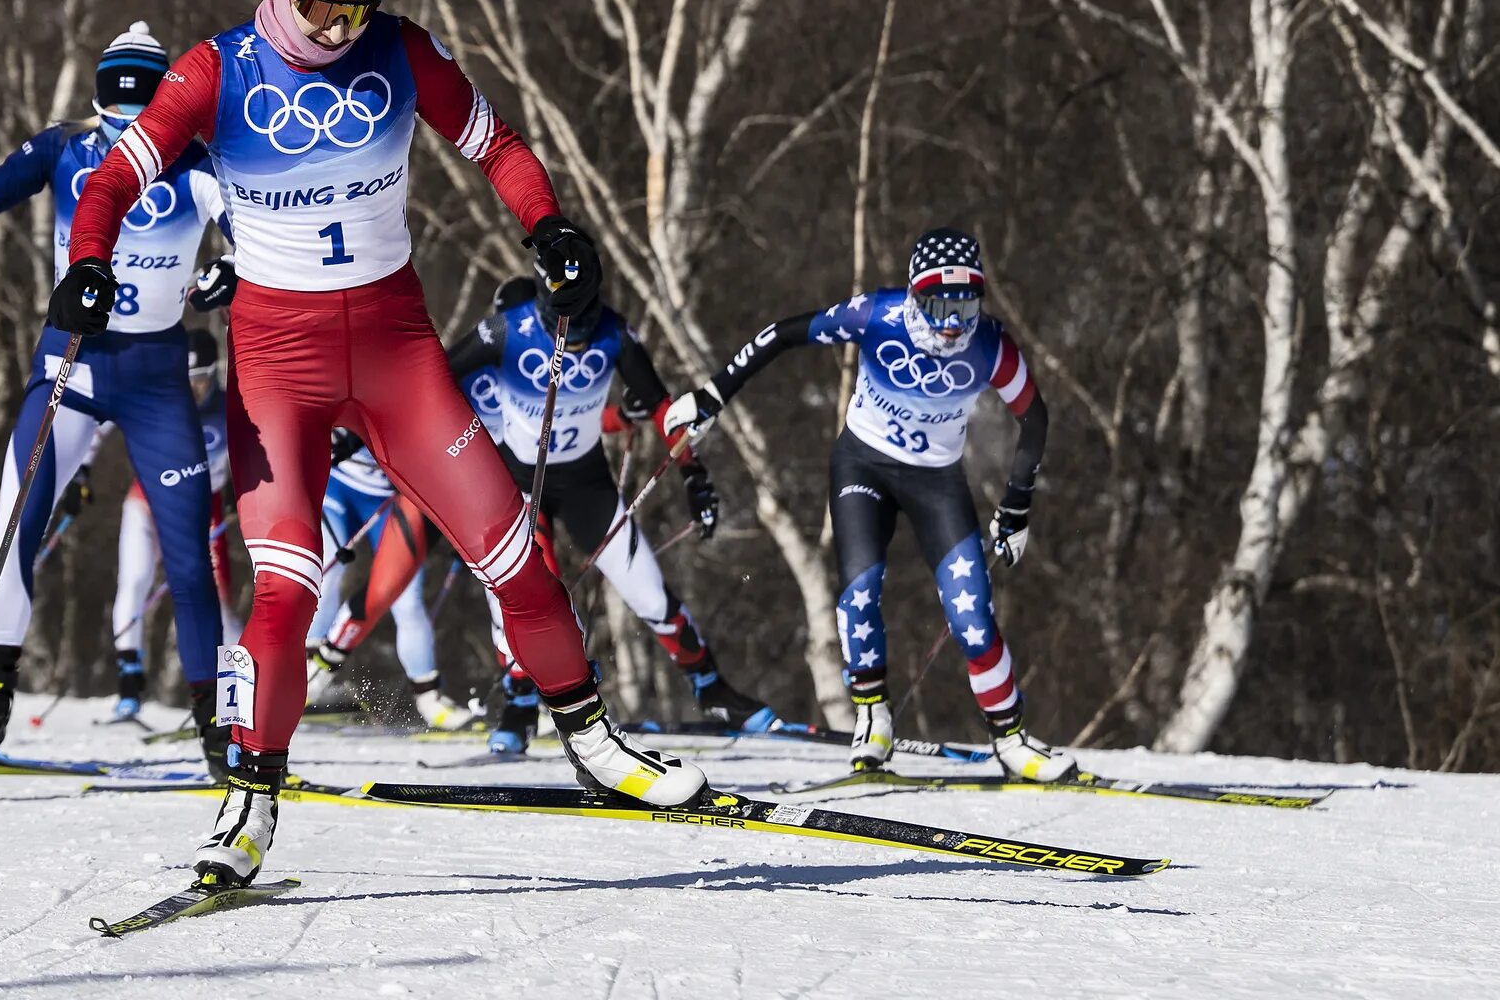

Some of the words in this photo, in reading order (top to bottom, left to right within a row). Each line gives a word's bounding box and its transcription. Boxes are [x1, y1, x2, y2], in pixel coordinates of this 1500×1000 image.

[232, 182, 334, 210] BEIJING
[318, 221, 354, 266] 1
[127, 254, 181, 270] 2022
[114, 283, 140, 316] 8
[550, 334, 565, 387] SWIX
[48, 358, 71, 412] SWIX
[446, 417, 481, 458] BOSCO
[536, 427, 579, 453] 42
[226, 684, 238, 707] 1
[651, 812, 746, 829] FISCHER
[954, 838, 1125, 874] FISCHER
